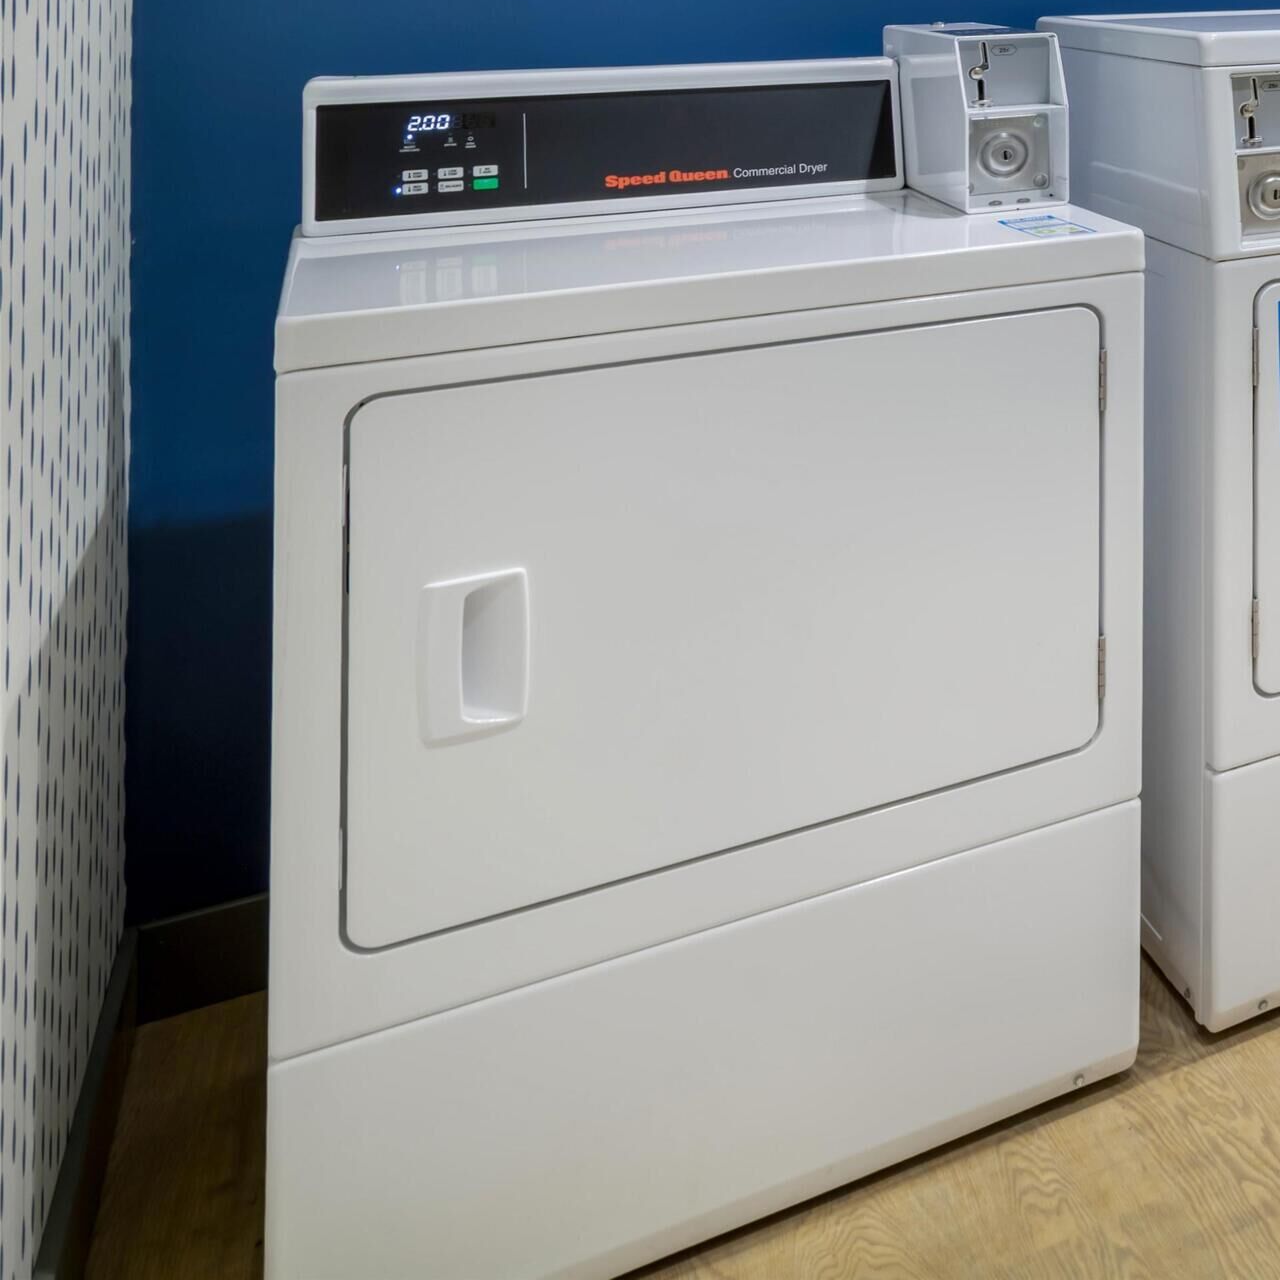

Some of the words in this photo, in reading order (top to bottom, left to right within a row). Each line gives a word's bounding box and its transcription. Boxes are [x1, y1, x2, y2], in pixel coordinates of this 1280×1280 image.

[407, 114, 450, 131] 2.00
[605, 171, 666, 189] Speed
[669, 169, 729, 183] Queen
[733, 164, 796, 178] Commercial
[799, 162, 828, 175] Dryer
